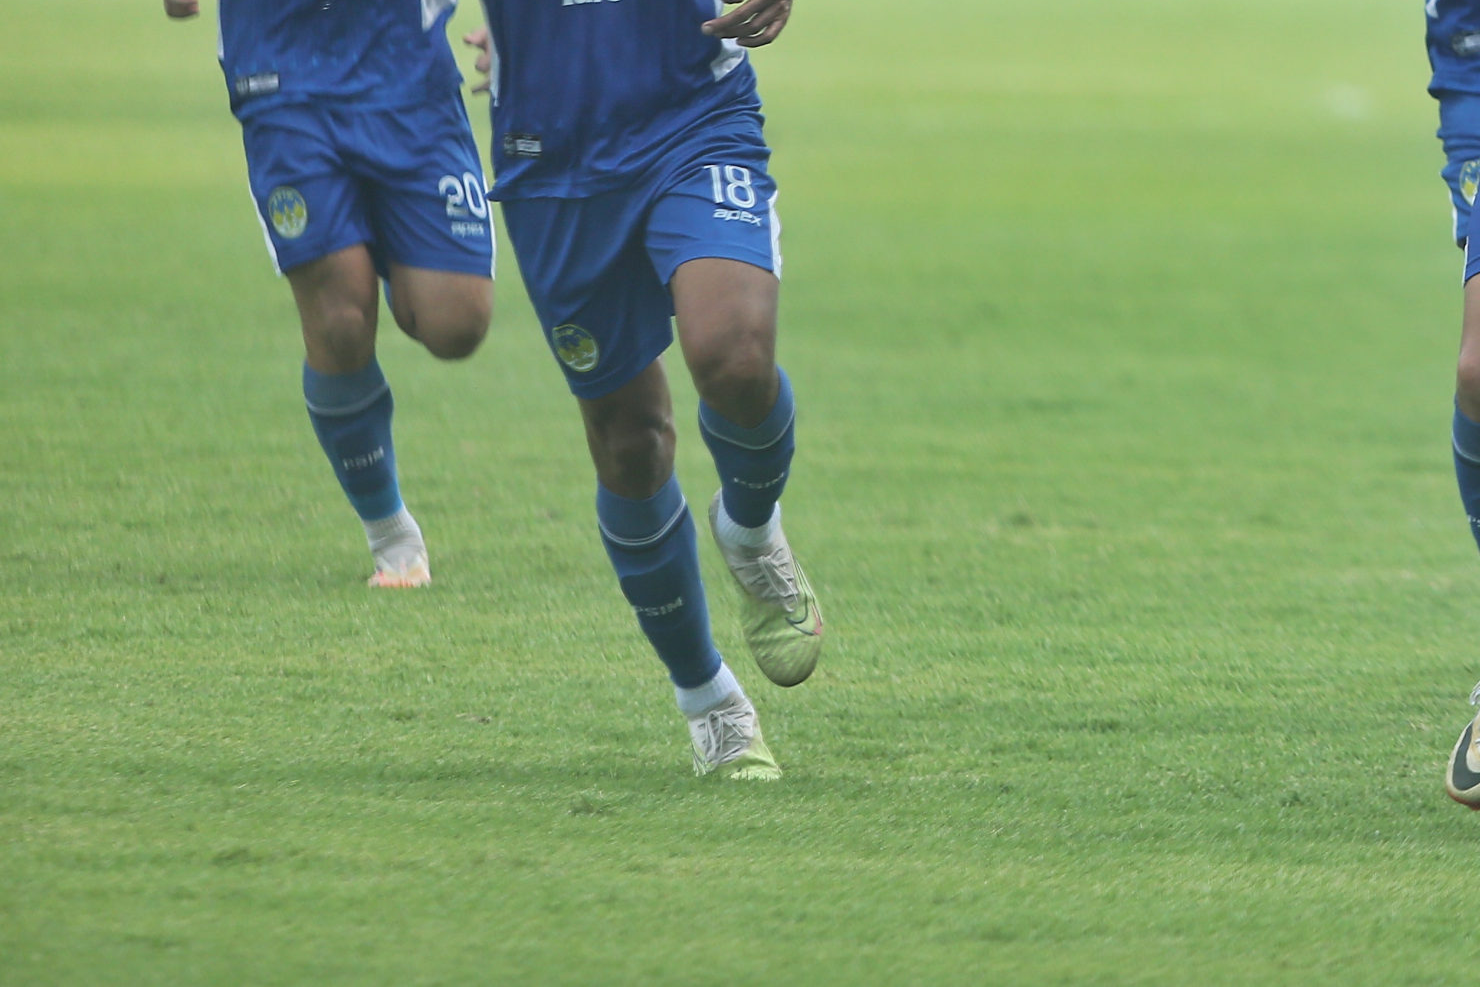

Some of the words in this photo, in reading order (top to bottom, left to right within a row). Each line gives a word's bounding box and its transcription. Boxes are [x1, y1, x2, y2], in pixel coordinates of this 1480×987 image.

[438, 171, 488, 219] 20
[703, 164, 755, 209] 18
[713, 208, 763, 227] apex
